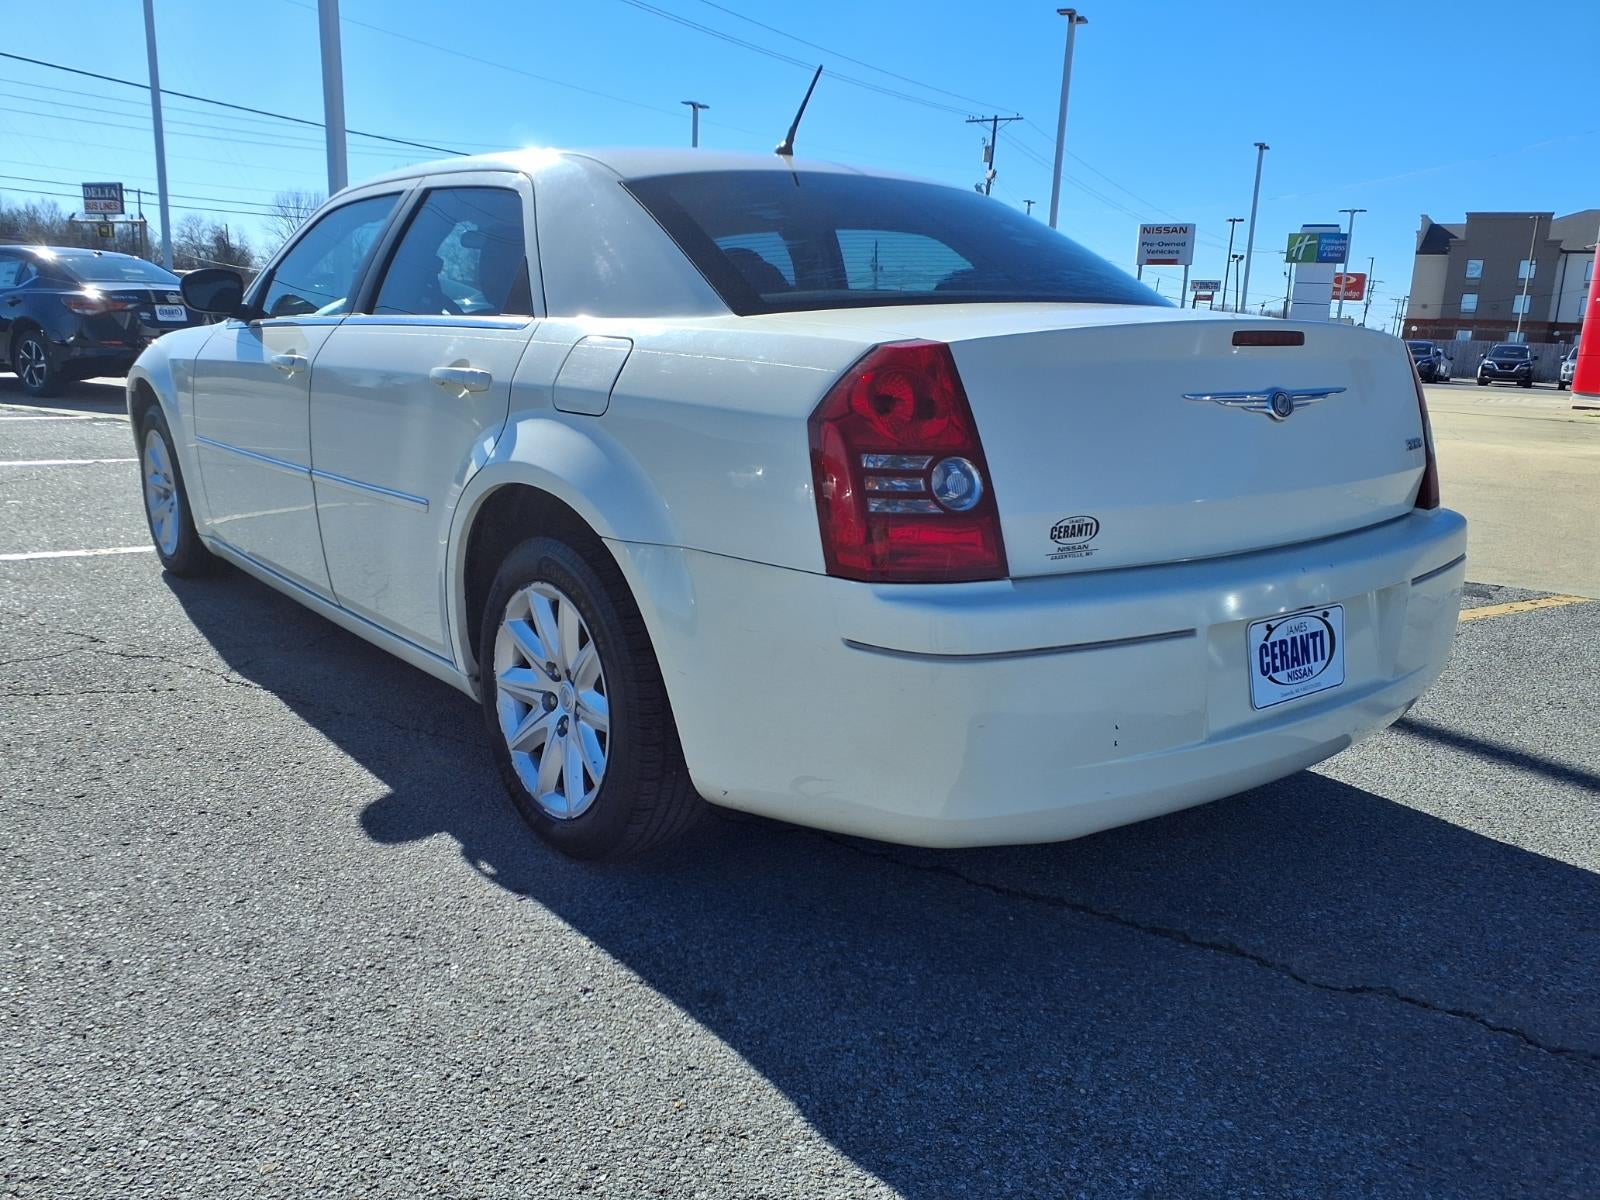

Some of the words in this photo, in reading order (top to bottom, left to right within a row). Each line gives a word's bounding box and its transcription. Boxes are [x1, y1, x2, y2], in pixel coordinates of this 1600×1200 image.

[84, 187, 117, 198] DELTA
[99, 200, 119, 210] LINES
[1142, 226, 1188, 234] NISSAN
[1050, 522, 1094, 540] CERANTI
[1057, 544, 1089, 552] NISSAN
[1286, 621, 1308, 635] JAMES
[1258, 630, 1326, 677] CERANTI
[1286, 666, 1314, 683] NISSAN
